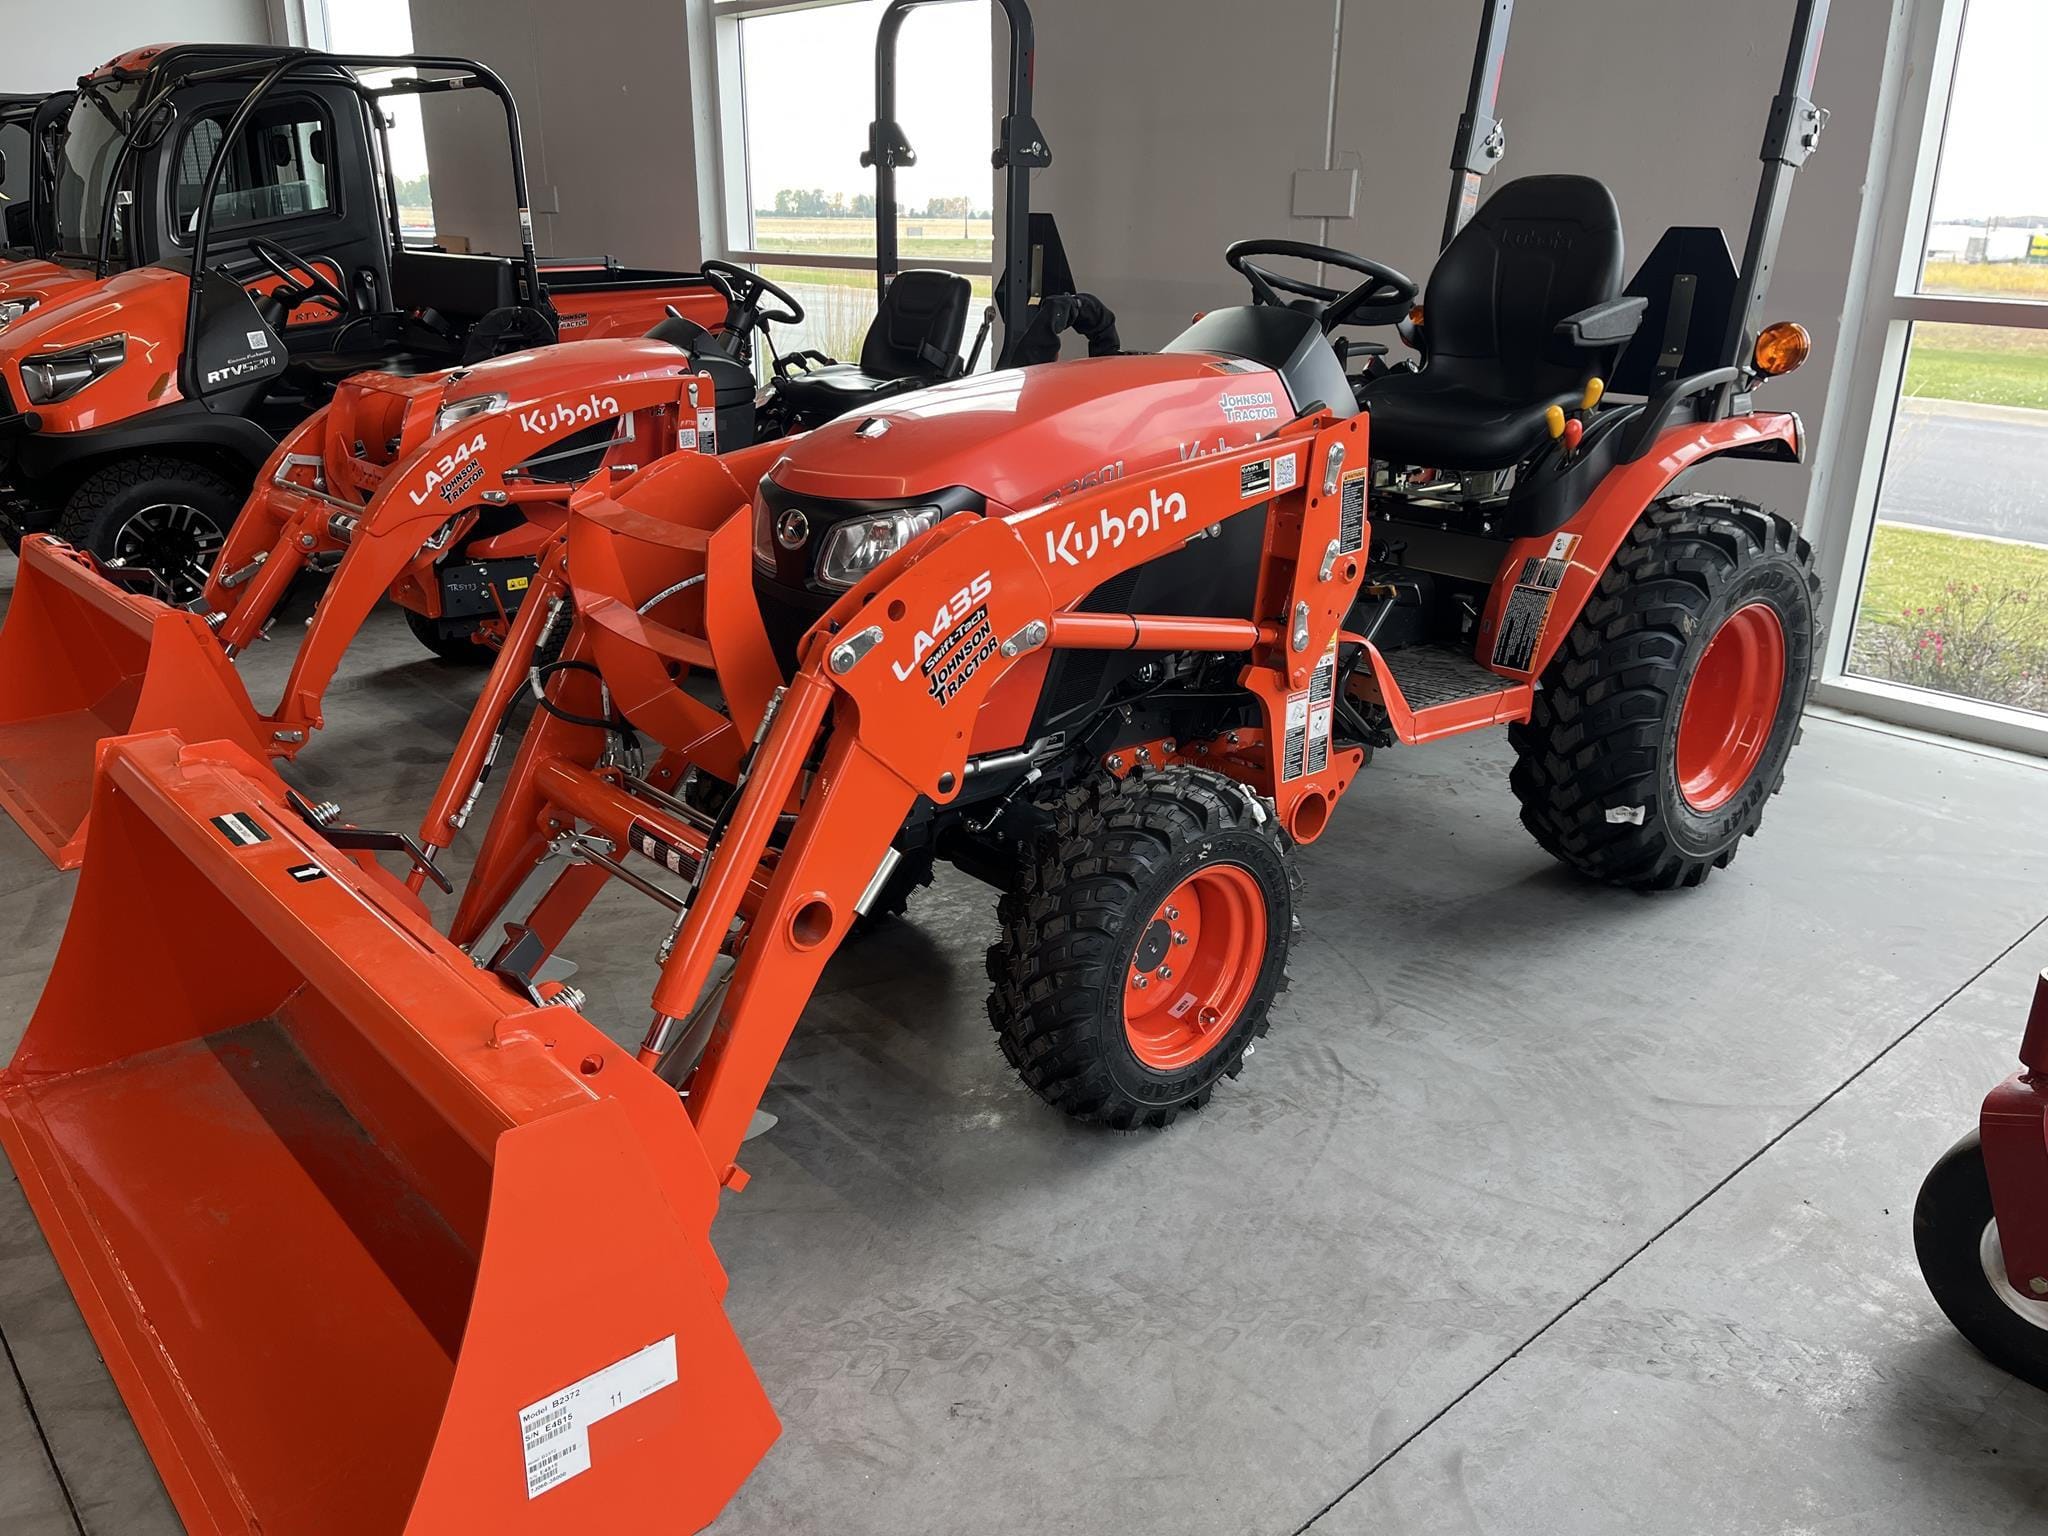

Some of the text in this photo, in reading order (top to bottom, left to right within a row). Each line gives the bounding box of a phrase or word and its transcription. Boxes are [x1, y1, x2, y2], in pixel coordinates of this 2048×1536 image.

[207, 355, 276, 384] RTV520
[519, 394, 620, 434] Kubota
[1220, 393, 1272, 408] JOHNSON
[1224, 406, 1277, 422] TRACTOR
[408, 433, 487, 506] LA344
[438, 459, 479, 498] JOHNSON
[443, 468, 485, 505] TRACTOR
[1045, 488, 1188, 567] Kubota
[891, 569, 993, 682] LA435
[924, 607, 986, 673] Swift-Tach
[927, 621, 992, 695] JOHNSON
[934, 637, 999, 707] TRACTOR
[523, 1389, 581, 1423] Model B2372
[610, 1391, 622, 1407] 11
[525, 1413, 573, 1442] S/N E4815
